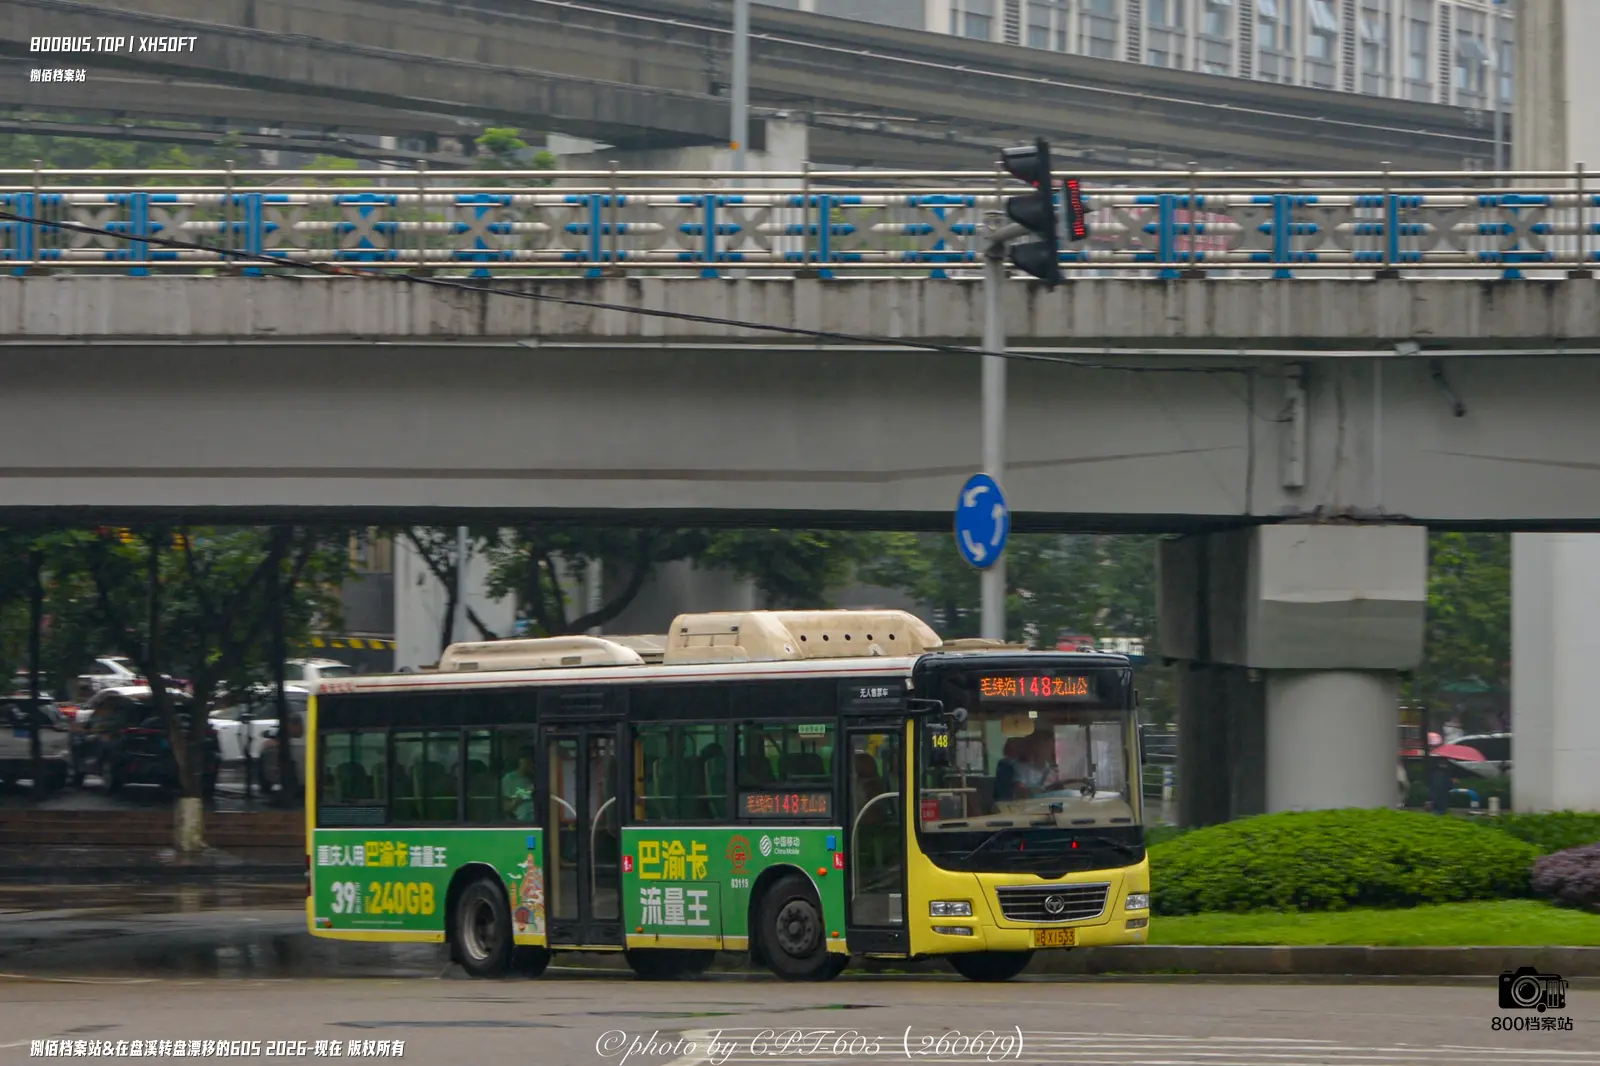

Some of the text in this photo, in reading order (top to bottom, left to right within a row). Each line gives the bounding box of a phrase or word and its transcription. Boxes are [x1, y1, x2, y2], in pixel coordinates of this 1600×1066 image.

[932, 735, 949, 748] 148
[773, 836, 800, 847] 中国移动
[638, 839, 708, 880] 巴渝卡
[330, 881, 354, 914] 39
[369, 882, 435, 915] 240GB
[640, 887, 710, 926] 流量王
